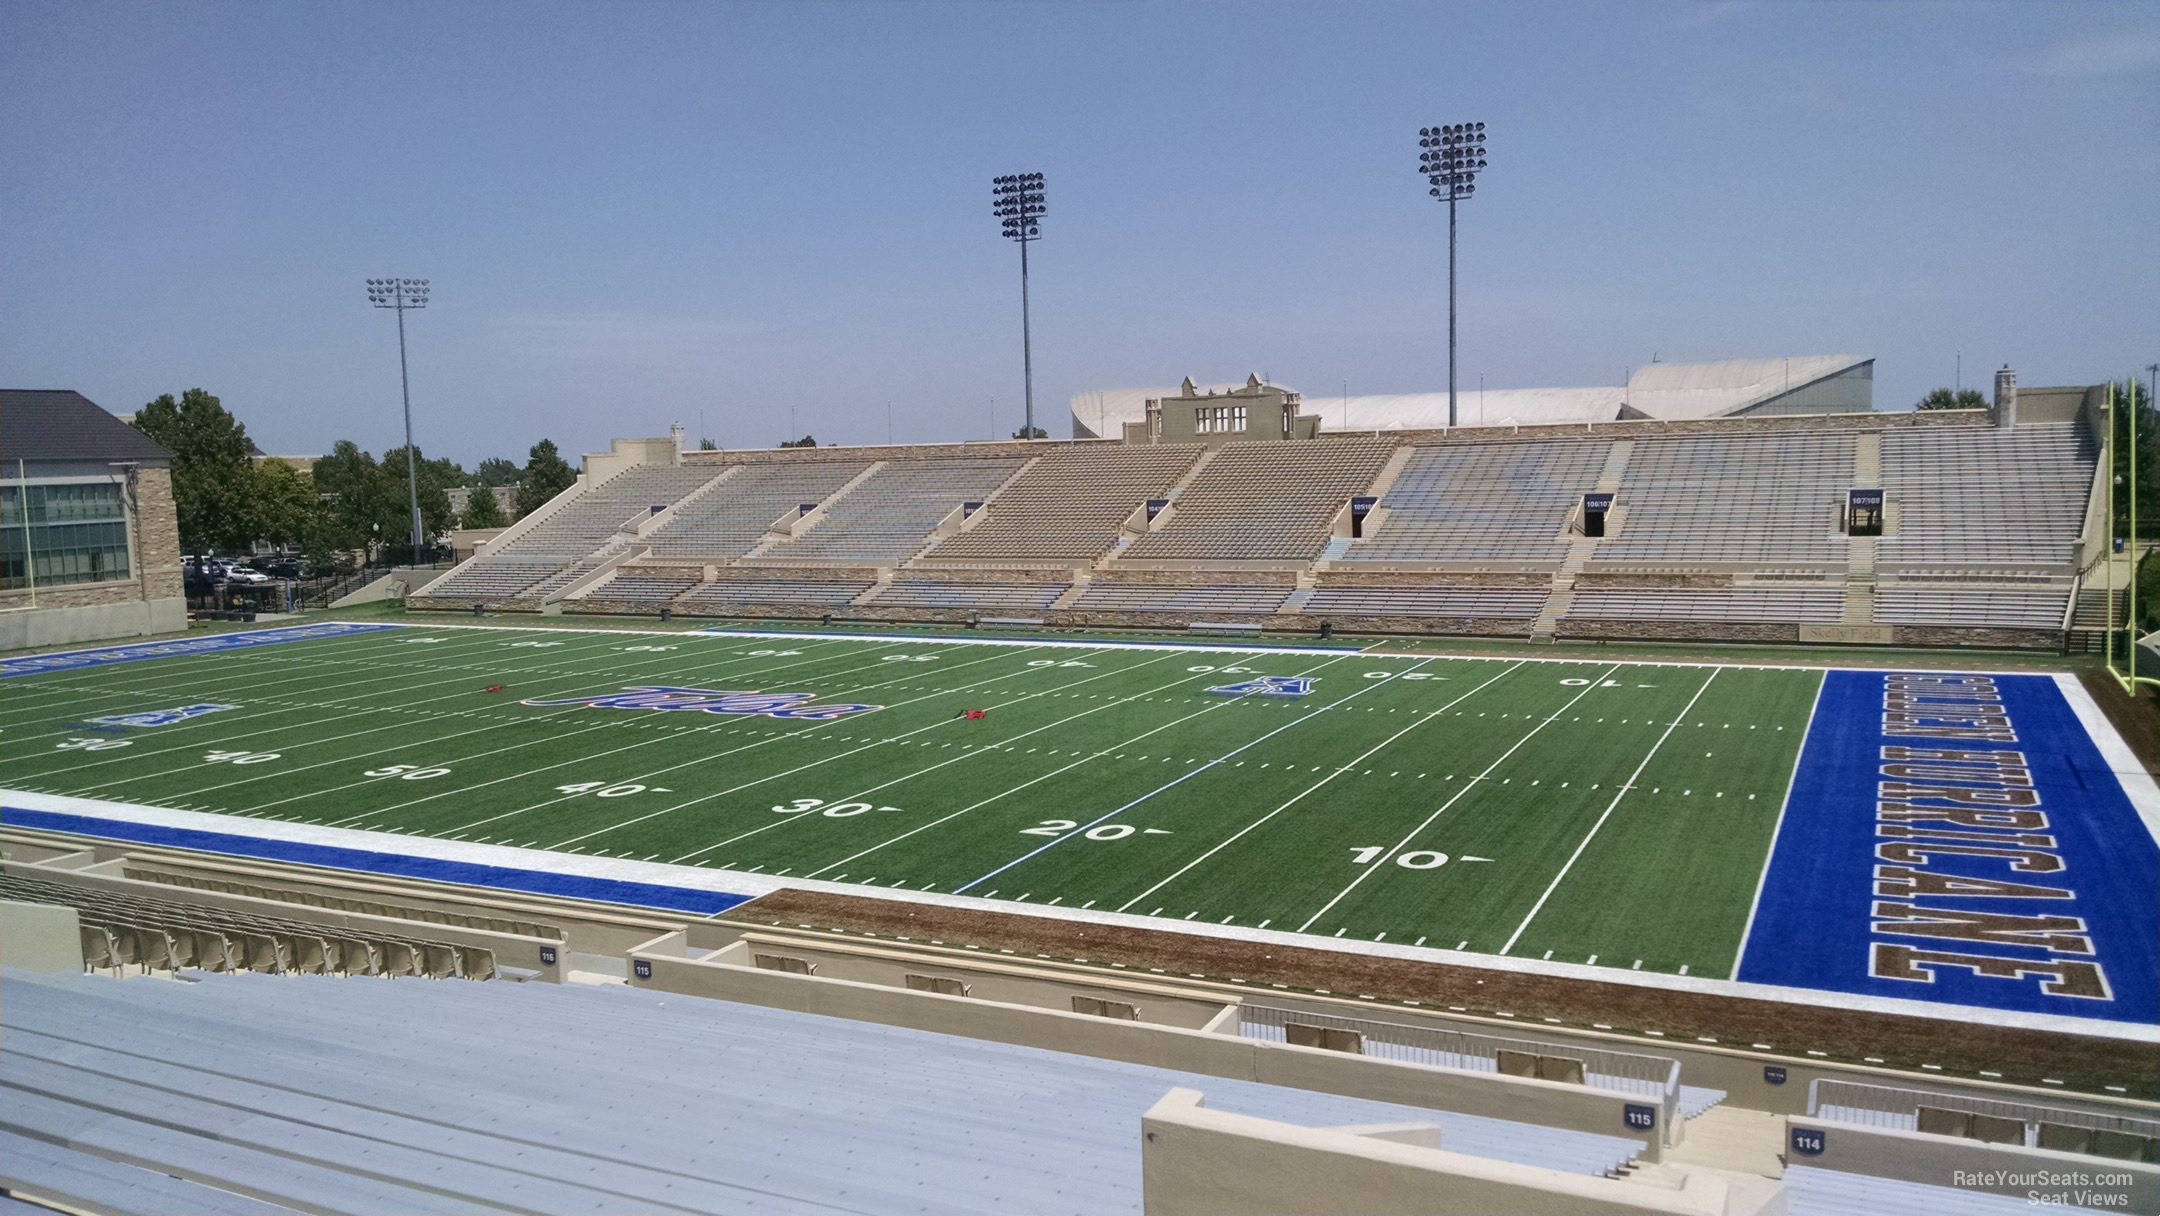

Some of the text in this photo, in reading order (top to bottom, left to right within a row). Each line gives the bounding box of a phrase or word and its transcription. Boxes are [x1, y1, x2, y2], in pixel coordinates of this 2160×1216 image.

[1809, 627, 1881, 641] Skelly Field
[364, 764, 452, 780] 50
[555, 781, 647, 798] 40
[772, 798, 873, 818] 30
[1019, 819, 1137, 841] 20
[1868, 673, 2115, 1001] GOLDEN HURRICANE
[1349, 845, 1449, 870] 10
[541, 952, 555, 962] 116
[636, 966, 650, 976] 115
[1628, 1112, 1652, 1126] 115
[1796, 1136, 1821, 1150] 114
